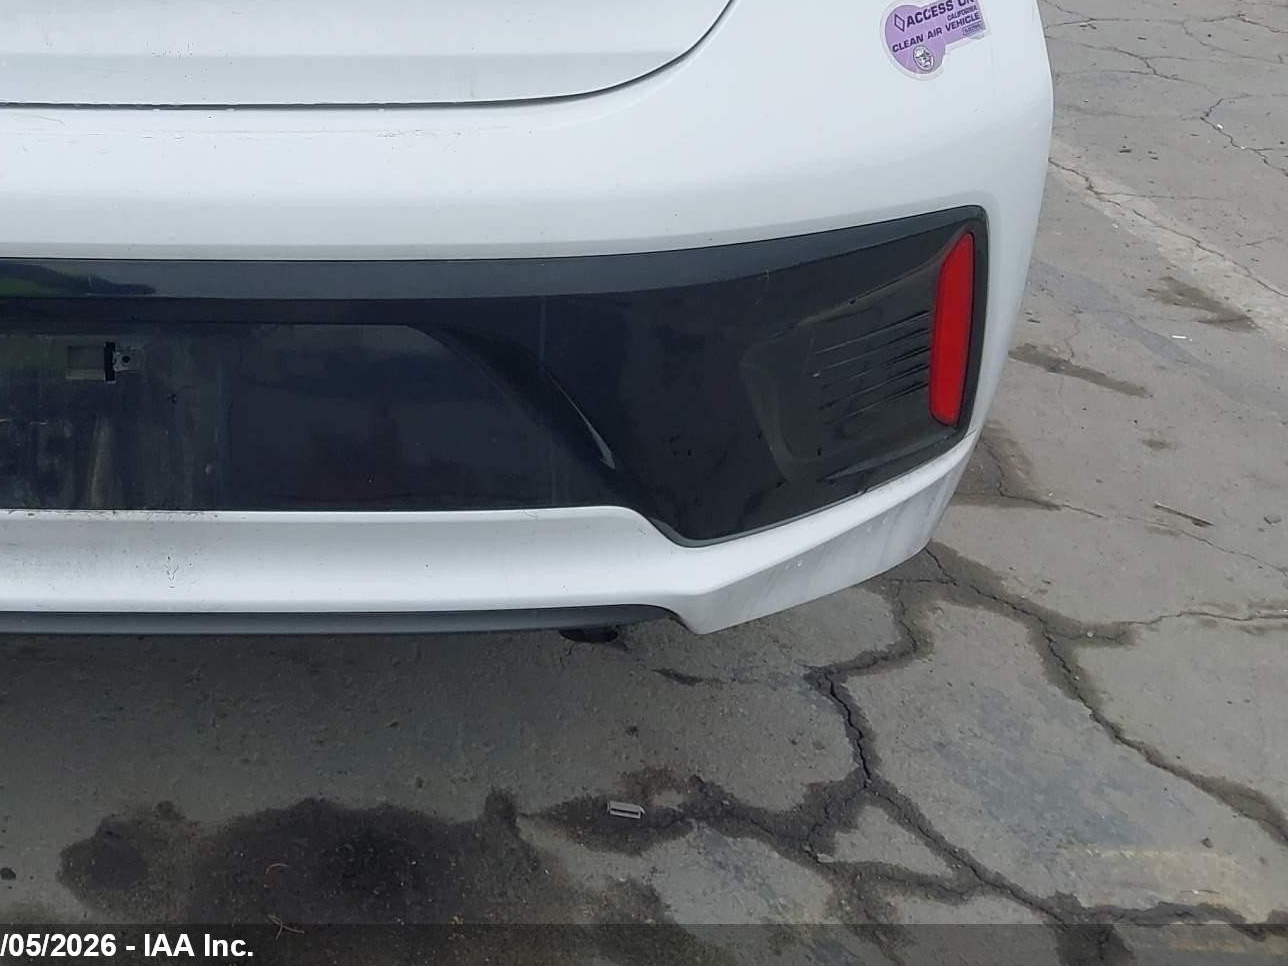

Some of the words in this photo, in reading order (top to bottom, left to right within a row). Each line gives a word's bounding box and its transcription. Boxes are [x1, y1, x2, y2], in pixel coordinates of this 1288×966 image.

[947, 4, 978, 21] CALIFORNIA
[892, 34, 924, 53] CLEAN
[927, 27, 943, 39] AIR
[945, 12, 980, 32] VEHICLE
